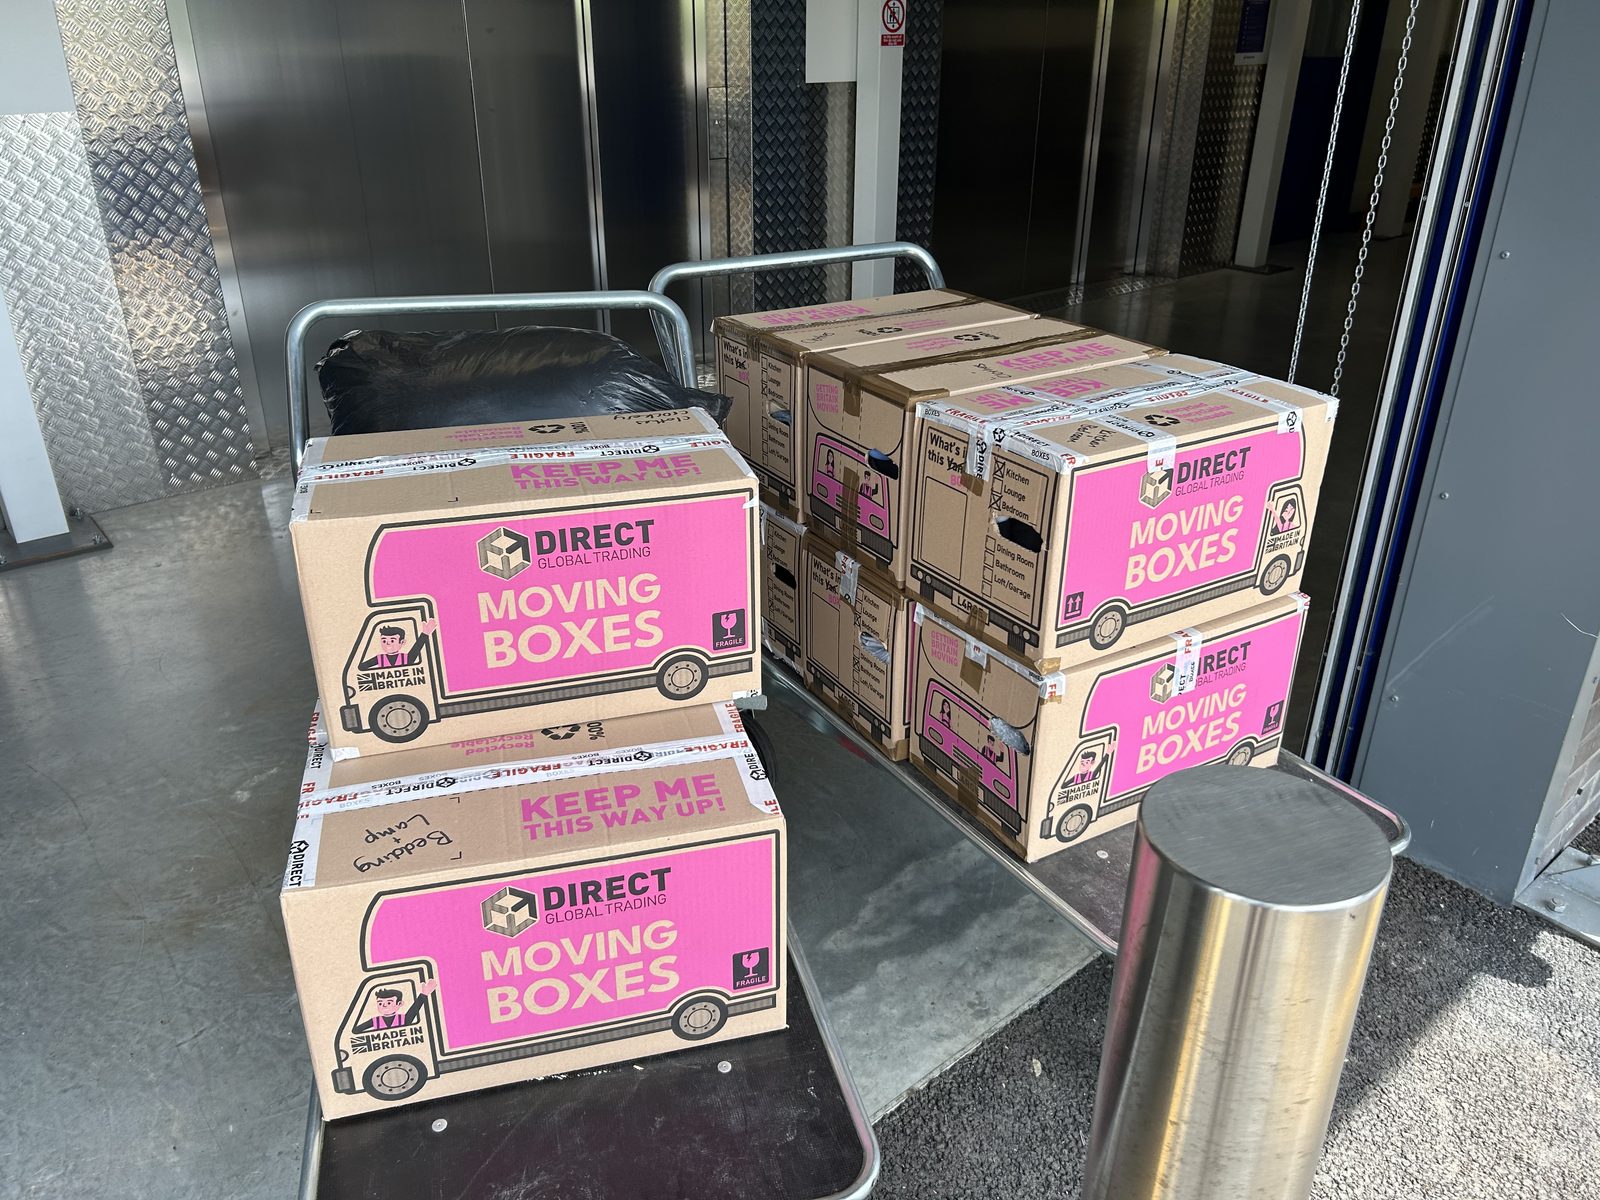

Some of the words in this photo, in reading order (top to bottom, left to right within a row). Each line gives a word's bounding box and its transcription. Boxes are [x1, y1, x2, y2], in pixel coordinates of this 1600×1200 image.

[768, 388, 784, 401] Bedroom
[1045, 379, 1111, 398] KEE
[924, 408, 940, 417] BOXES
[600, 448, 642, 457] DIRECT
[930, 432, 960, 456] What's
[510, 451, 575, 460] FRAGILE
[928, 449, 944, 465] this
[1031, 449, 1050, 461] BOXES
[511, 459, 622, 479] KEEP
[636, 455, 697, 473] ME
[1176, 447, 1252, 484] DIRECT
[515, 477, 580, 490] THIS
[586, 471, 651, 486] WAY
[655, 466, 702, 479] UP!
[1005, 468, 1030, 486] Kitchen
[1175, 481, 1208, 497] GLOBAL
[1210, 471, 1245, 488] TRADING
[1004, 485, 1026, 501] Lounge
[1002, 501, 1029, 520] Bedroom
[1129, 495, 1244, 549] MOVING
[535, 519, 655, 555] DIRECT
[1274, 538, 1299, 552] BRITAIN
[1275, 531, 1293, 543] MADE
[1293, 529, 1300, 537] IN
[538, 553, 592, 569] GLOBAL
[593, 546, 651, 563] TRADING
[996, 544, 1016, 563] Dining
[1016, 554, 1034, 569] Room
[1125, 528, 1239, 590] BOXES
[812, 572, 824, 586] this
[813, 559, 834, 580] What's
[995, 559, 1025, 580] Bathroom
[994, 575, 1031, 600] Loft/Garage
[477, 572, 661, 623] MOVING
[863, 594, 880, 611] Kitchen
[863, 608, 878, 622] Lounge
[861, 620, 880, 638] Bedroom
[930, 630, 959, 646] GETTING
[483, 610, 664, 669] BOXES
[715, 637, 743, 648] FRAGILE
[931, 640, 959, 657] BRITAIN
[860, 653, 873, 667] Dining
[873, 661, 886, 675] Room
[931, 650, 959, 667] MOVING
[1197, 641, 1252, 676] IRECT
[375, 667, 409, 680] MADE
[412, 666, 425, 676] IN
[860, 664, 881, 685] Bathroom
[1214, 662, 1247, 681] TRADING
[377, 676, 426, 690] BRITAIN
[724, 703, 745, 733] FRAGILE
[1141, 683, 1247, 740] MOVING
[587, 721, 605, 740] 00%
[450, 733, 533, 748] Recyclable
[465, 741, 534, 755] Recycled
[1136, 711, 1242, 775] BOXES
[588, 755, 632, 767] DIRECT
[492, 763, 562, 779] FRAGILE
[372, 780, 401, 789] BOXES
[386, 783, 434, 795] DIRECT
[1070, 782, 1091, 795] MADE
[1092, 780, 1100, 788] IN
[521, 783, 641, 823] KEEP
[654, 773, 721, 803] ME
[1069, 788, 1099, 802] BRITAIN
[523, 815, 594, 841] THIS
[600, 805, 667, 828] WAY
[675, 797, 726, 817] UP!
[364, 814, 430, 844] Lamp
[353, 830, 453, 873] Bedding
[289, 854, 305, 886] DIRECT
[542, 867, 672, 911] DIRECT
[545, 905, 603, 925] GLOBAL
[604, 893, 667, 917] TRADING
[480, 919, 678, 981] MOVING
[486, 955, 680, 1024] BOXES
[736, 975, 767, 988] FRAGILE
[371, 1029, 407, 1042] MADE
[410, 1026, 423, 1036] IN
[372, 1035, 424, 1051] BRITAIN
